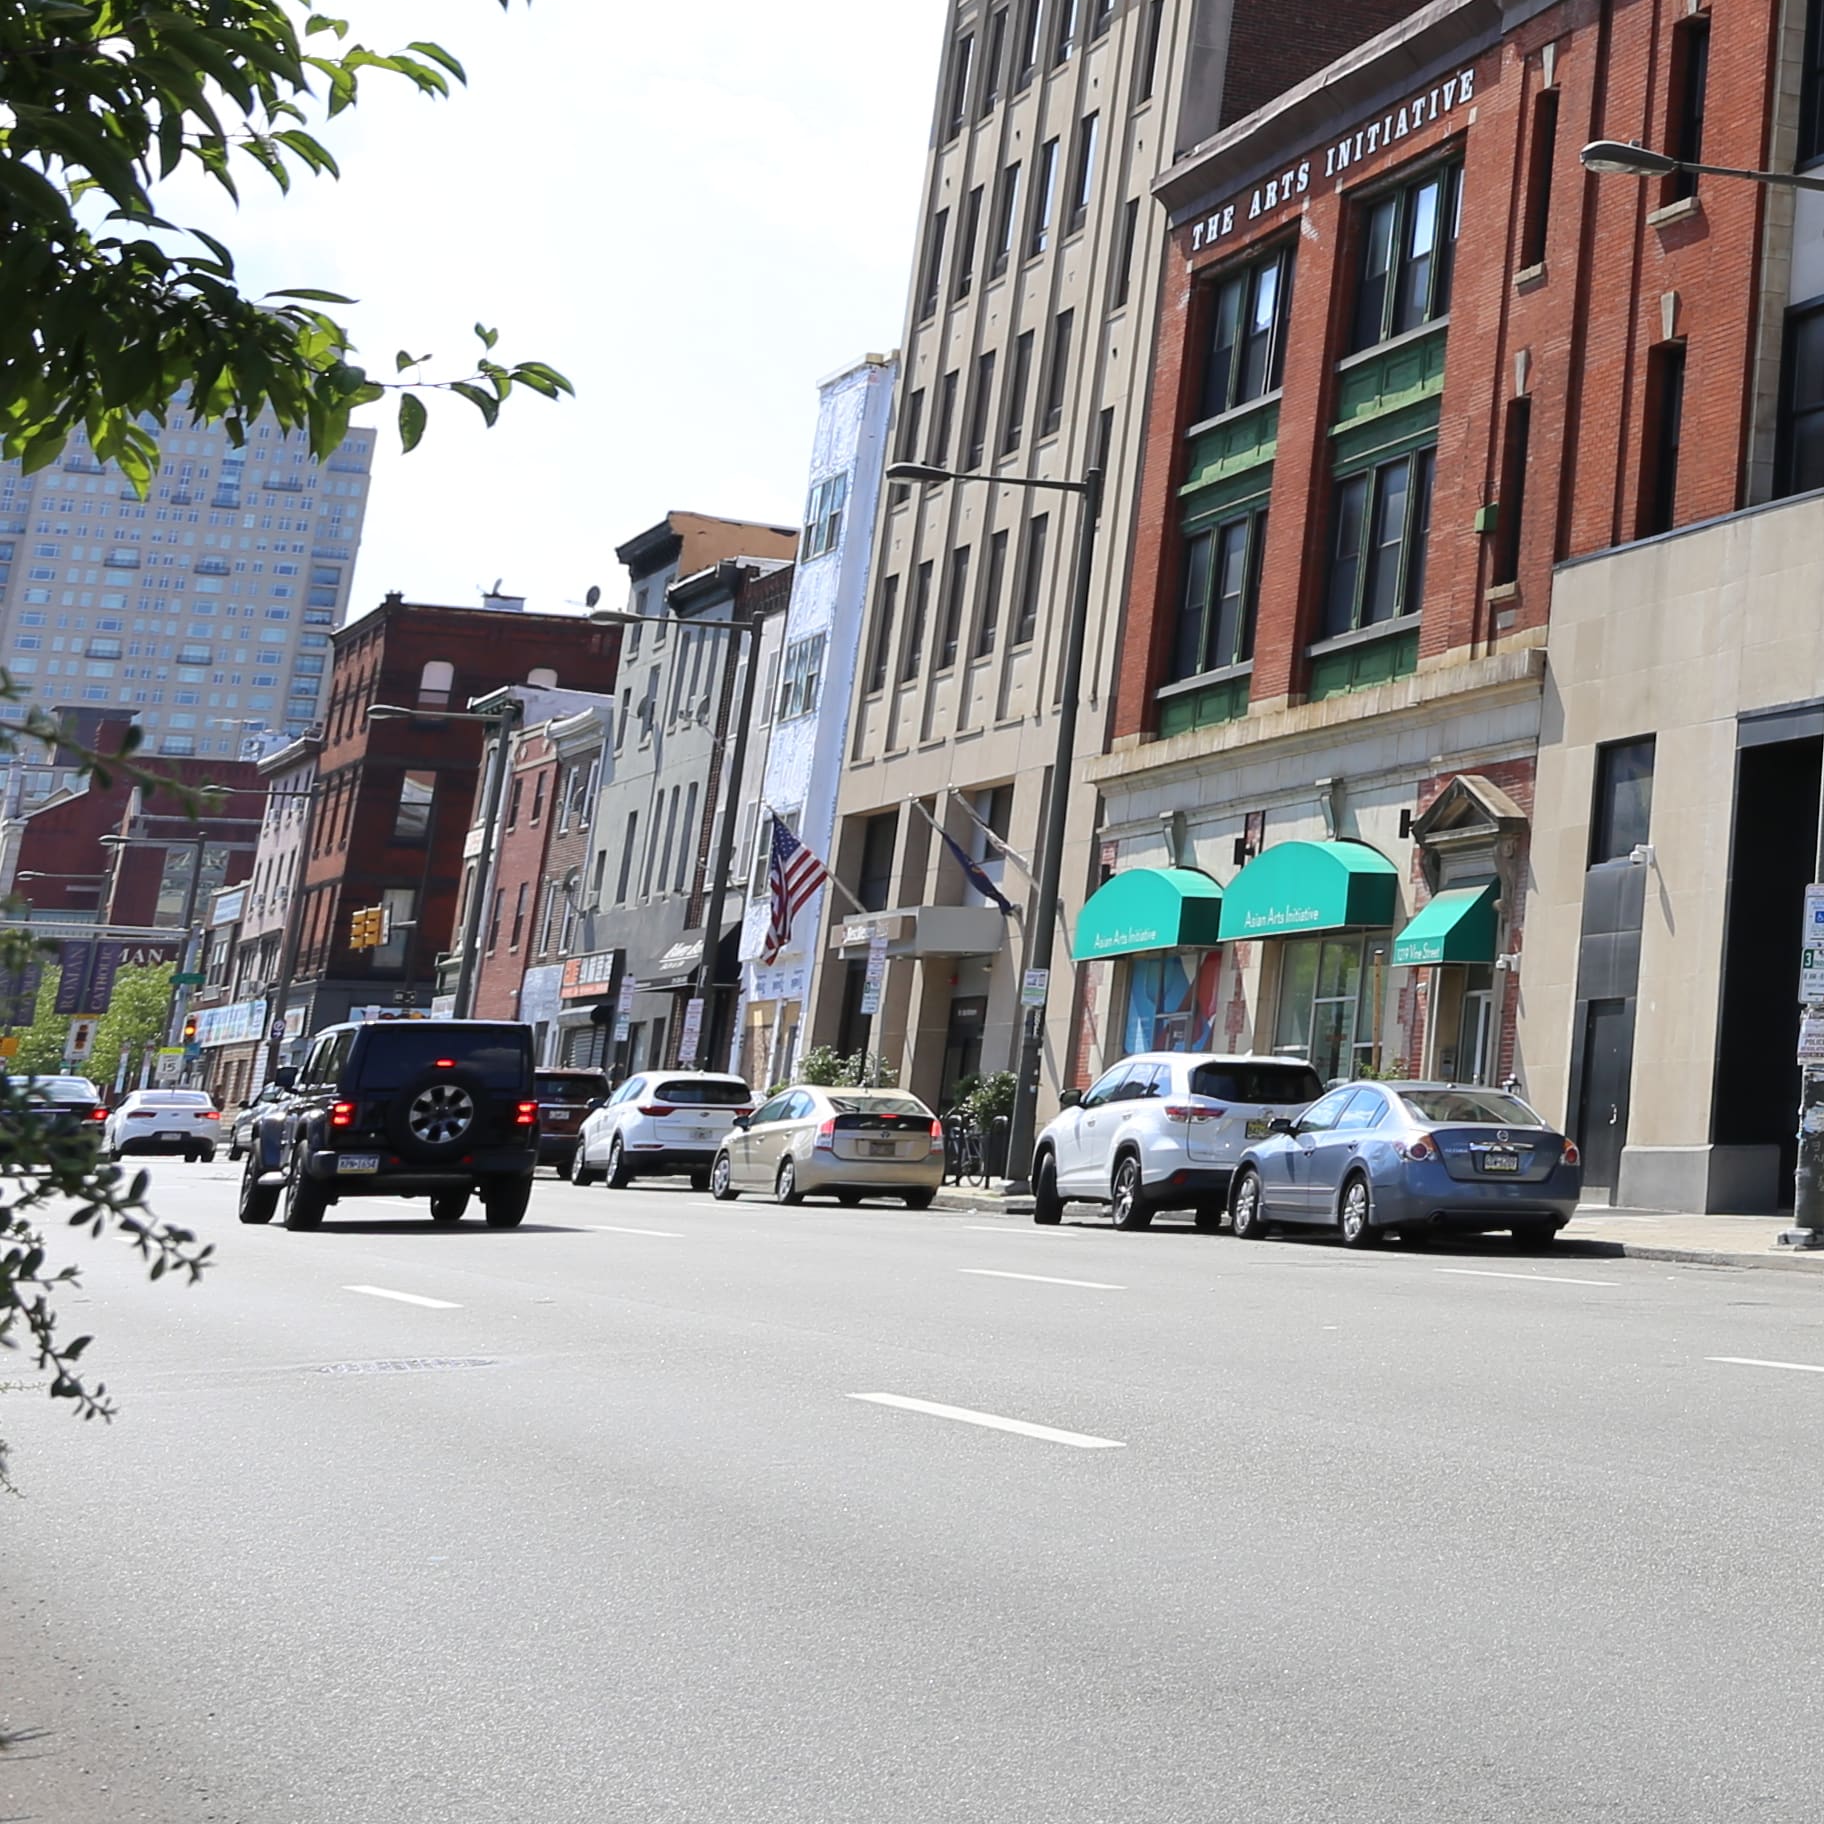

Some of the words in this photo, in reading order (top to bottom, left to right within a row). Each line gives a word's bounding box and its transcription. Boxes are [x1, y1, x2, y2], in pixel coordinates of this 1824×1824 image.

[1191, 205, 1235, 252] THE
[1248, 161, 1311, 219] ARTS
[1325, 68, 1476, 177] INITIATIVE
[1244, 910, 1267, 928] Asian
[1267, 907, 1284, 925] Arts
[1286, 903, 1319, 923] Initiative
[1094, 933, 1113, 949] Asian
[1113, 928, 1128, 945] Arts
[1128, 925, 1156, 943] Initiative
[1410, 943, 1422, 960] Vine
[1804, 953, 1811, 967] 3
[60, 946, 87, 1009] ROMAN
[91, 947, 114, 1011] CATHOLIC
[162, 1062, 177, 1073] 15
